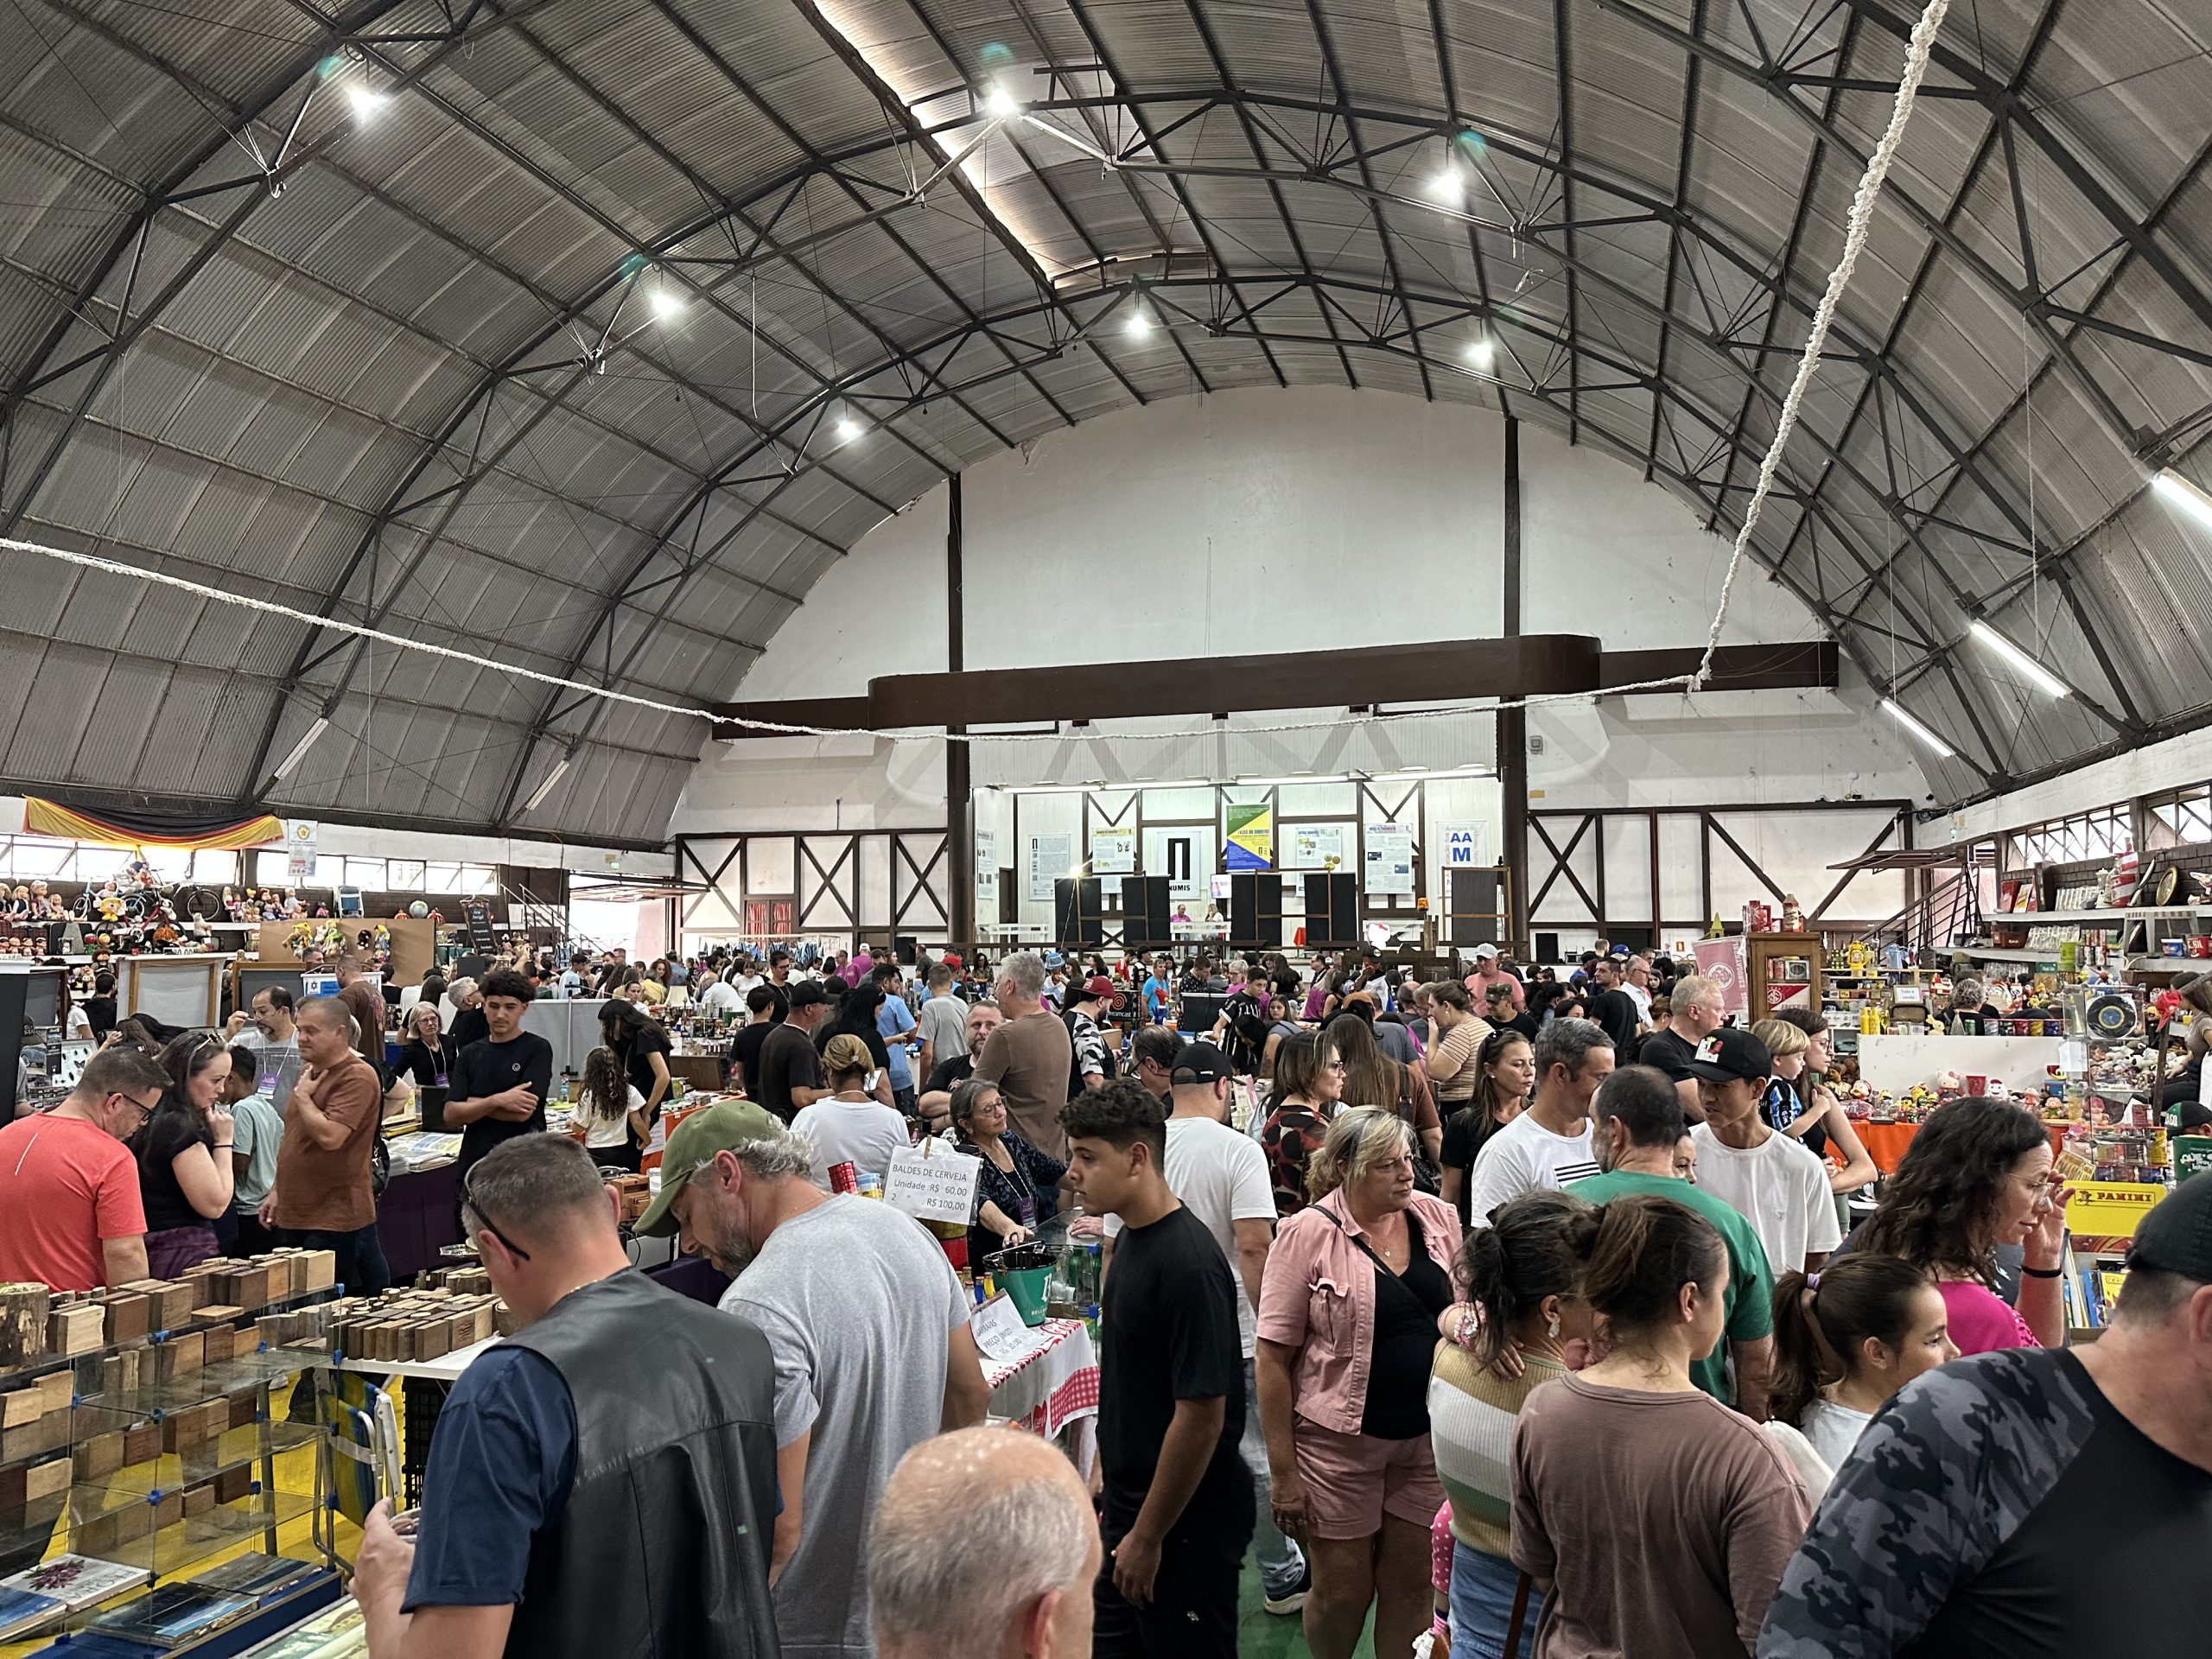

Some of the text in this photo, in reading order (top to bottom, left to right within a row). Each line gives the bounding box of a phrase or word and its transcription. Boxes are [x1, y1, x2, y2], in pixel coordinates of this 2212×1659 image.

[1450, 832, 1472, 843] AA
[1452, 847, 1471, 862] M
[893, 1164, 967, 1182] BALDES DE CERVEJA
[894, 1179, 925, 1191] Unidade
[944, 1185, 968, 1197] 60,00
[2096, 1192, 2152, 1202] PANINI
[938, 1200, 965, 1211] 100,00
[982, 1335, 1001, 1350] PREÇO
